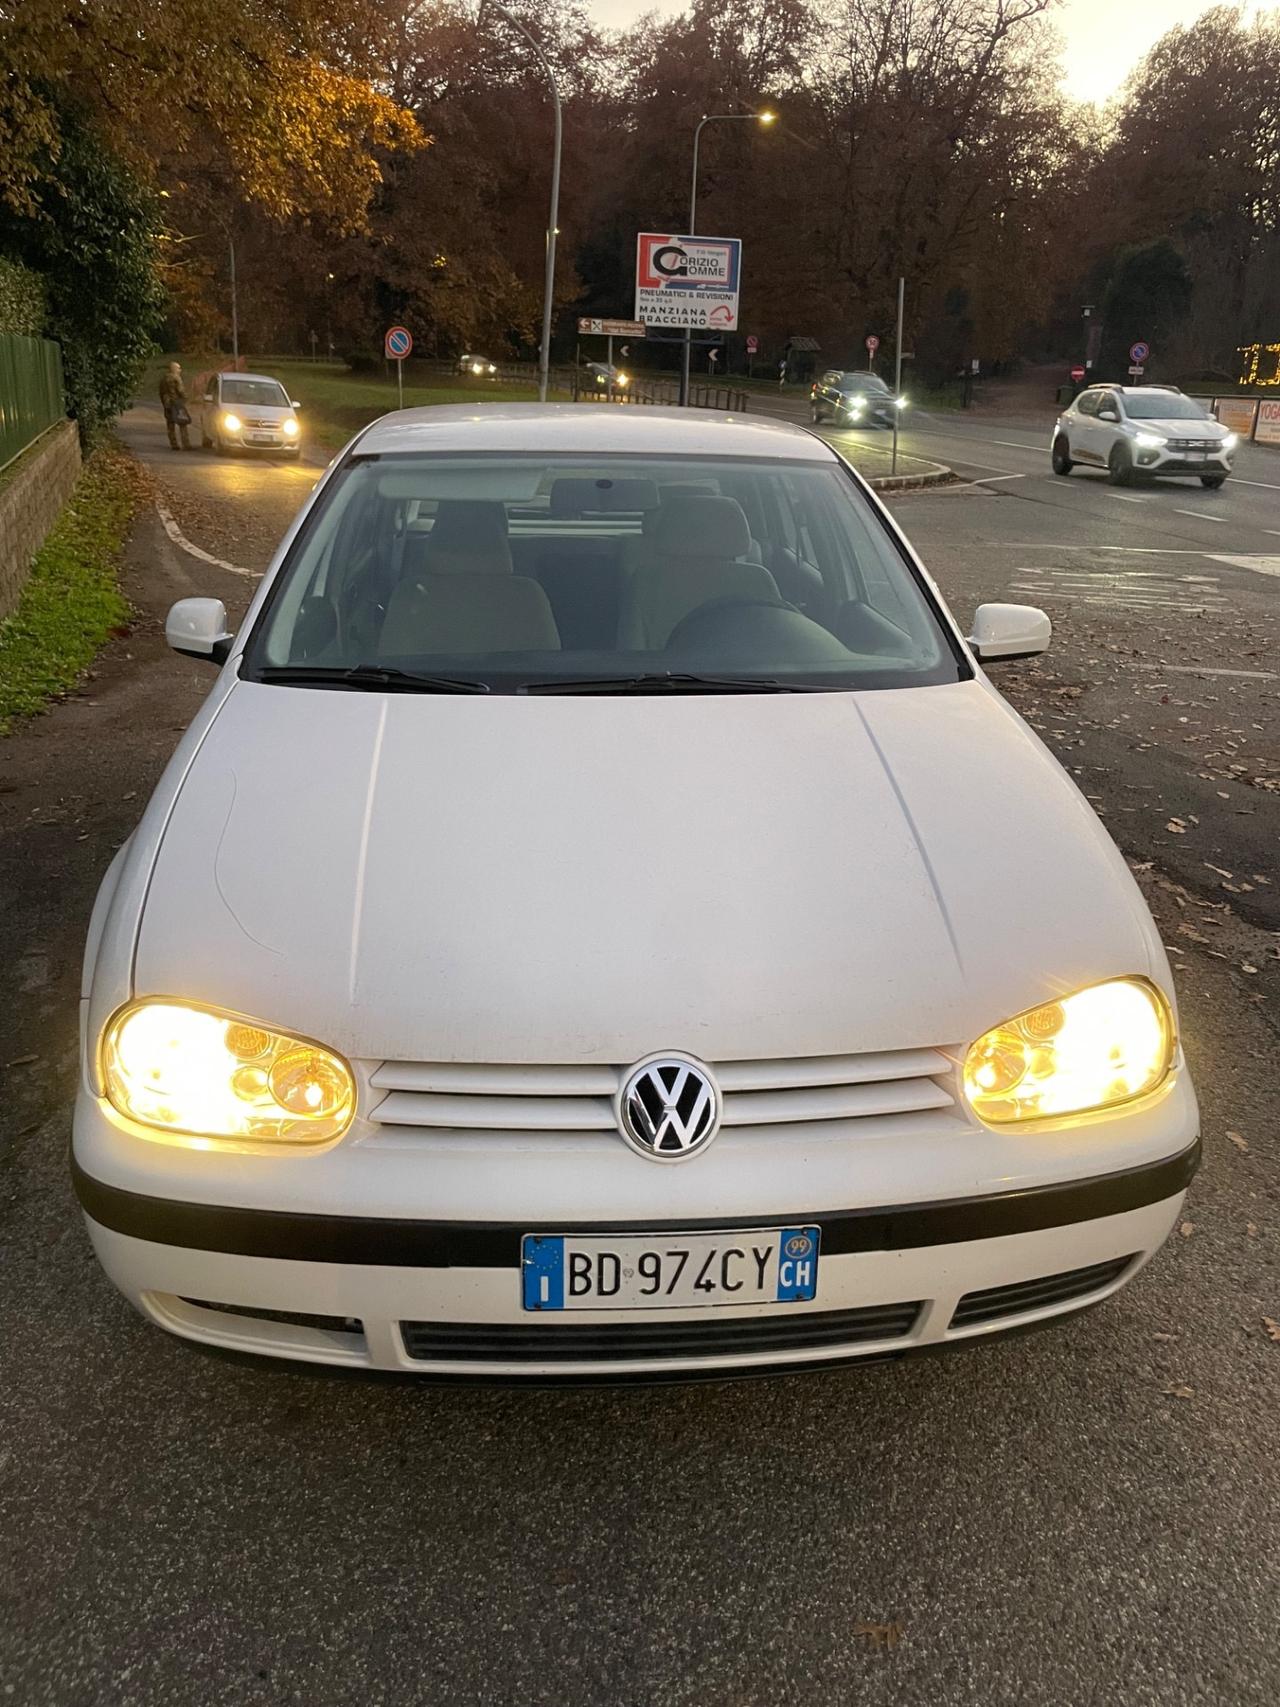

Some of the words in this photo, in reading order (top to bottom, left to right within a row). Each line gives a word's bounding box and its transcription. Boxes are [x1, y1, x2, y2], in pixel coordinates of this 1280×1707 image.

[640, 289, 687, 299] PNEUMATICI
[640, 305, 707, 316] MANZIANA
[640, 315, 706, 326] BRACCIANO
[790, 1238, 808, 1252] 99
[569, 1252, 621, 1296] BD
[780, 1261, 810, 1287] CH
